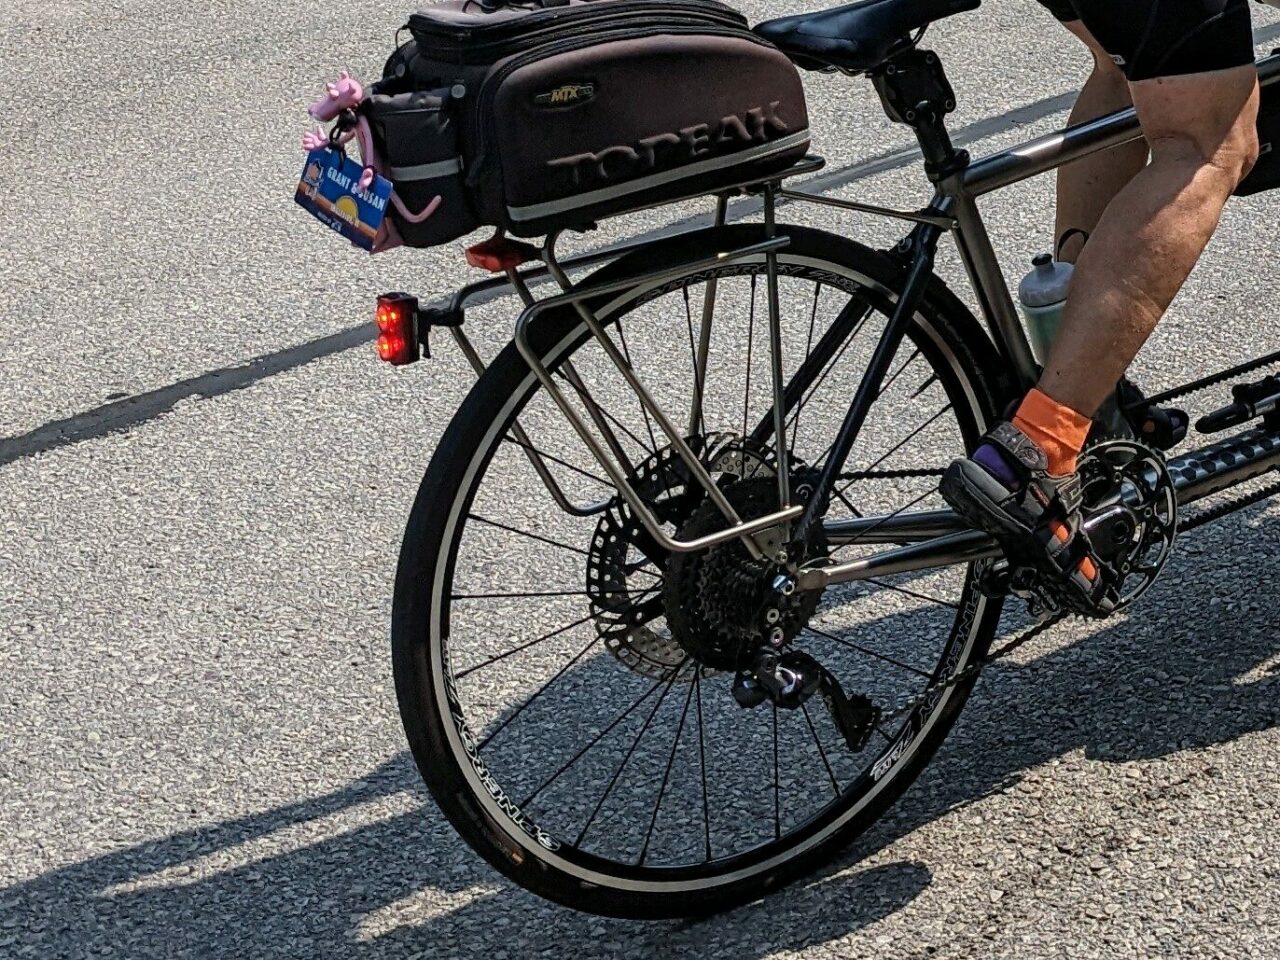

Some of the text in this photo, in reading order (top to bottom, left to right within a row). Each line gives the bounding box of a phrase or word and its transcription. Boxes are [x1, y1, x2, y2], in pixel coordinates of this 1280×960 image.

[551, 86, 578, 103] MTX
[547, 100, 788, 186] TOPEAK
[327, 167, 351, 190] GRANT
